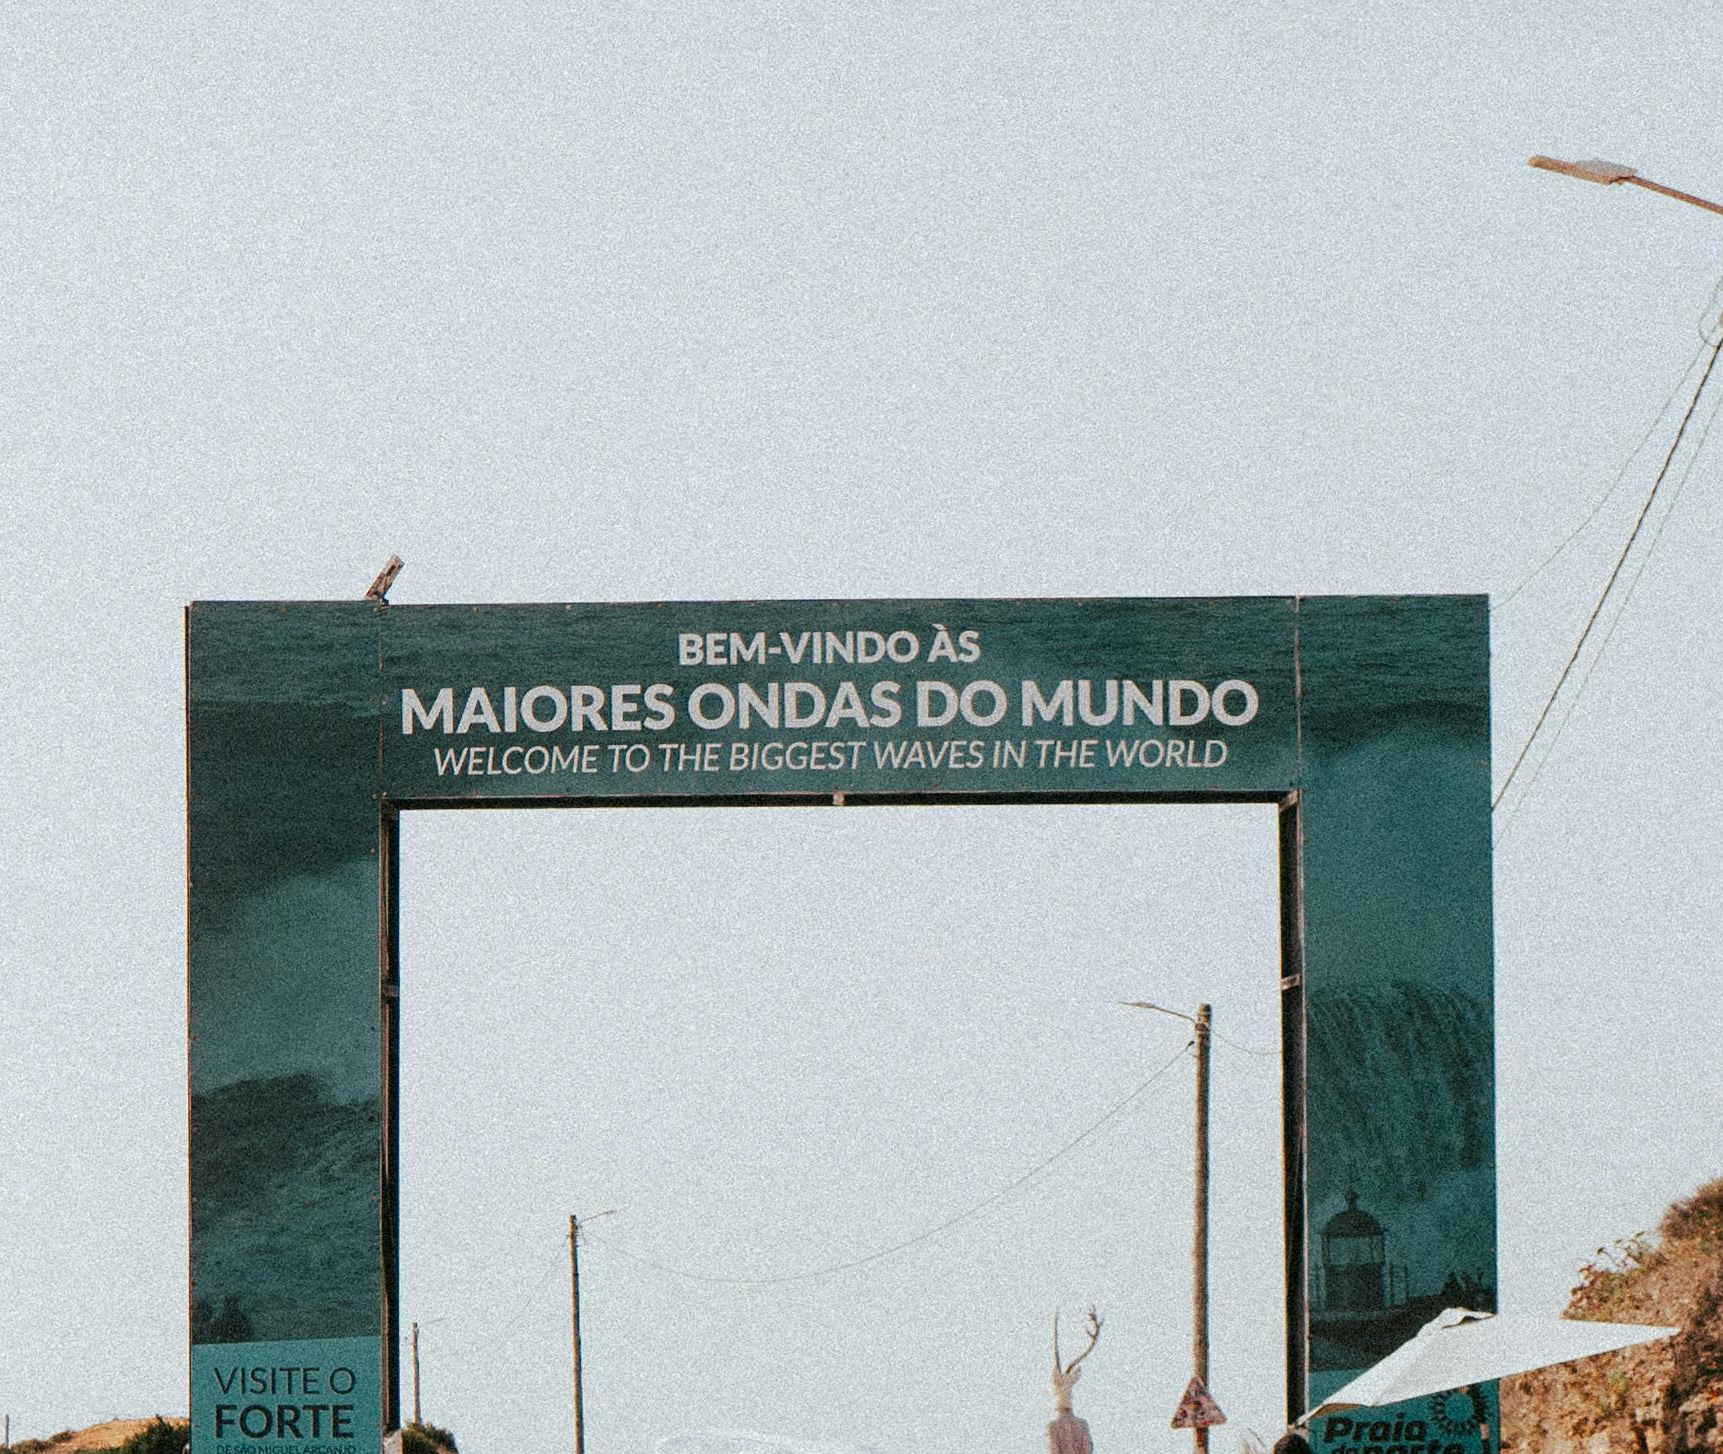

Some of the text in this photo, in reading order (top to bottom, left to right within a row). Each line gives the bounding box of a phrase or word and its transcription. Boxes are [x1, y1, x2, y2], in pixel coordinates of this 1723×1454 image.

[678, 623, 981, 666] BEM-VINDO ÀS
[401, 679, 1260, 735] MAIORES ONDAS DO MUNDO
[433, 739, 1229, 775] WELCOME TO THE BIGGEST WAVES IN THE WORLD
[214, 1366, 357, 1395] VISITE O
[214, 1404, 355, 1439] FORTE
[1324, 1412, 1428, 1443] Praia
